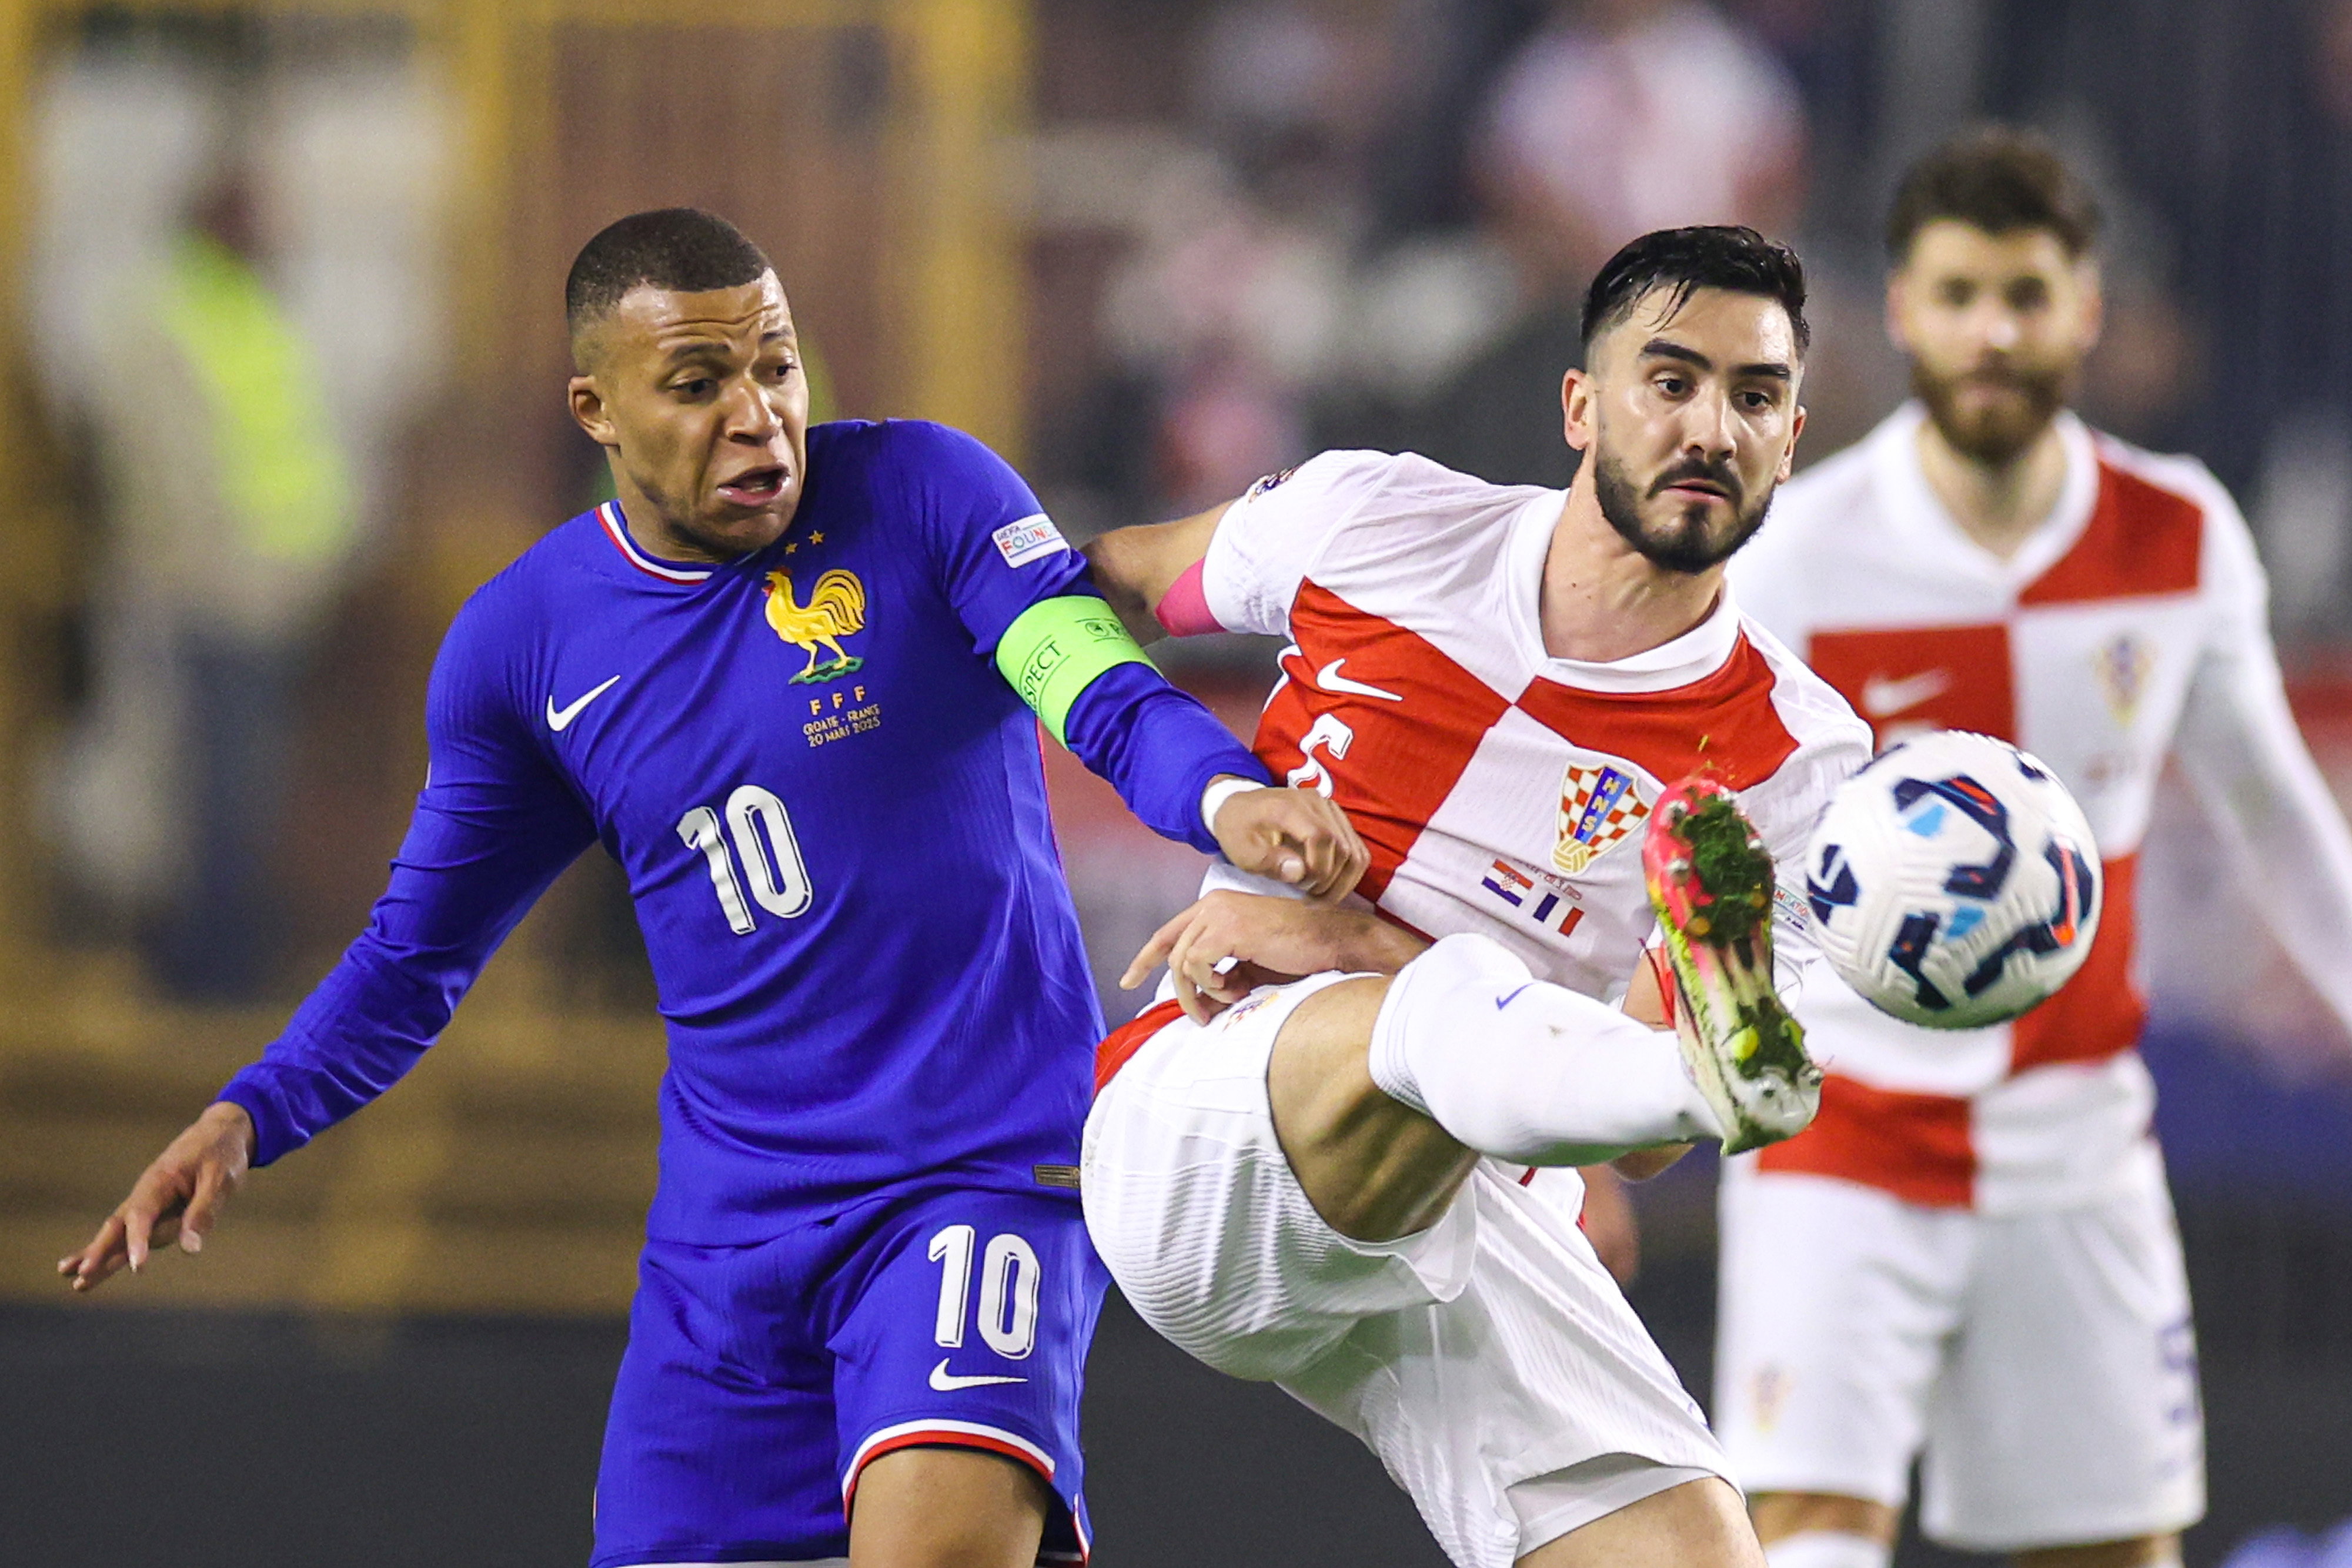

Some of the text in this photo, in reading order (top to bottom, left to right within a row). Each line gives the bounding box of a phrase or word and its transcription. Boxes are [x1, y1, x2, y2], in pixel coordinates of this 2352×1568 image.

[807, 733, 824, 747] 20
[676, 784, 813, 935] 10
[927, 1225, 1041, 1360] 10
